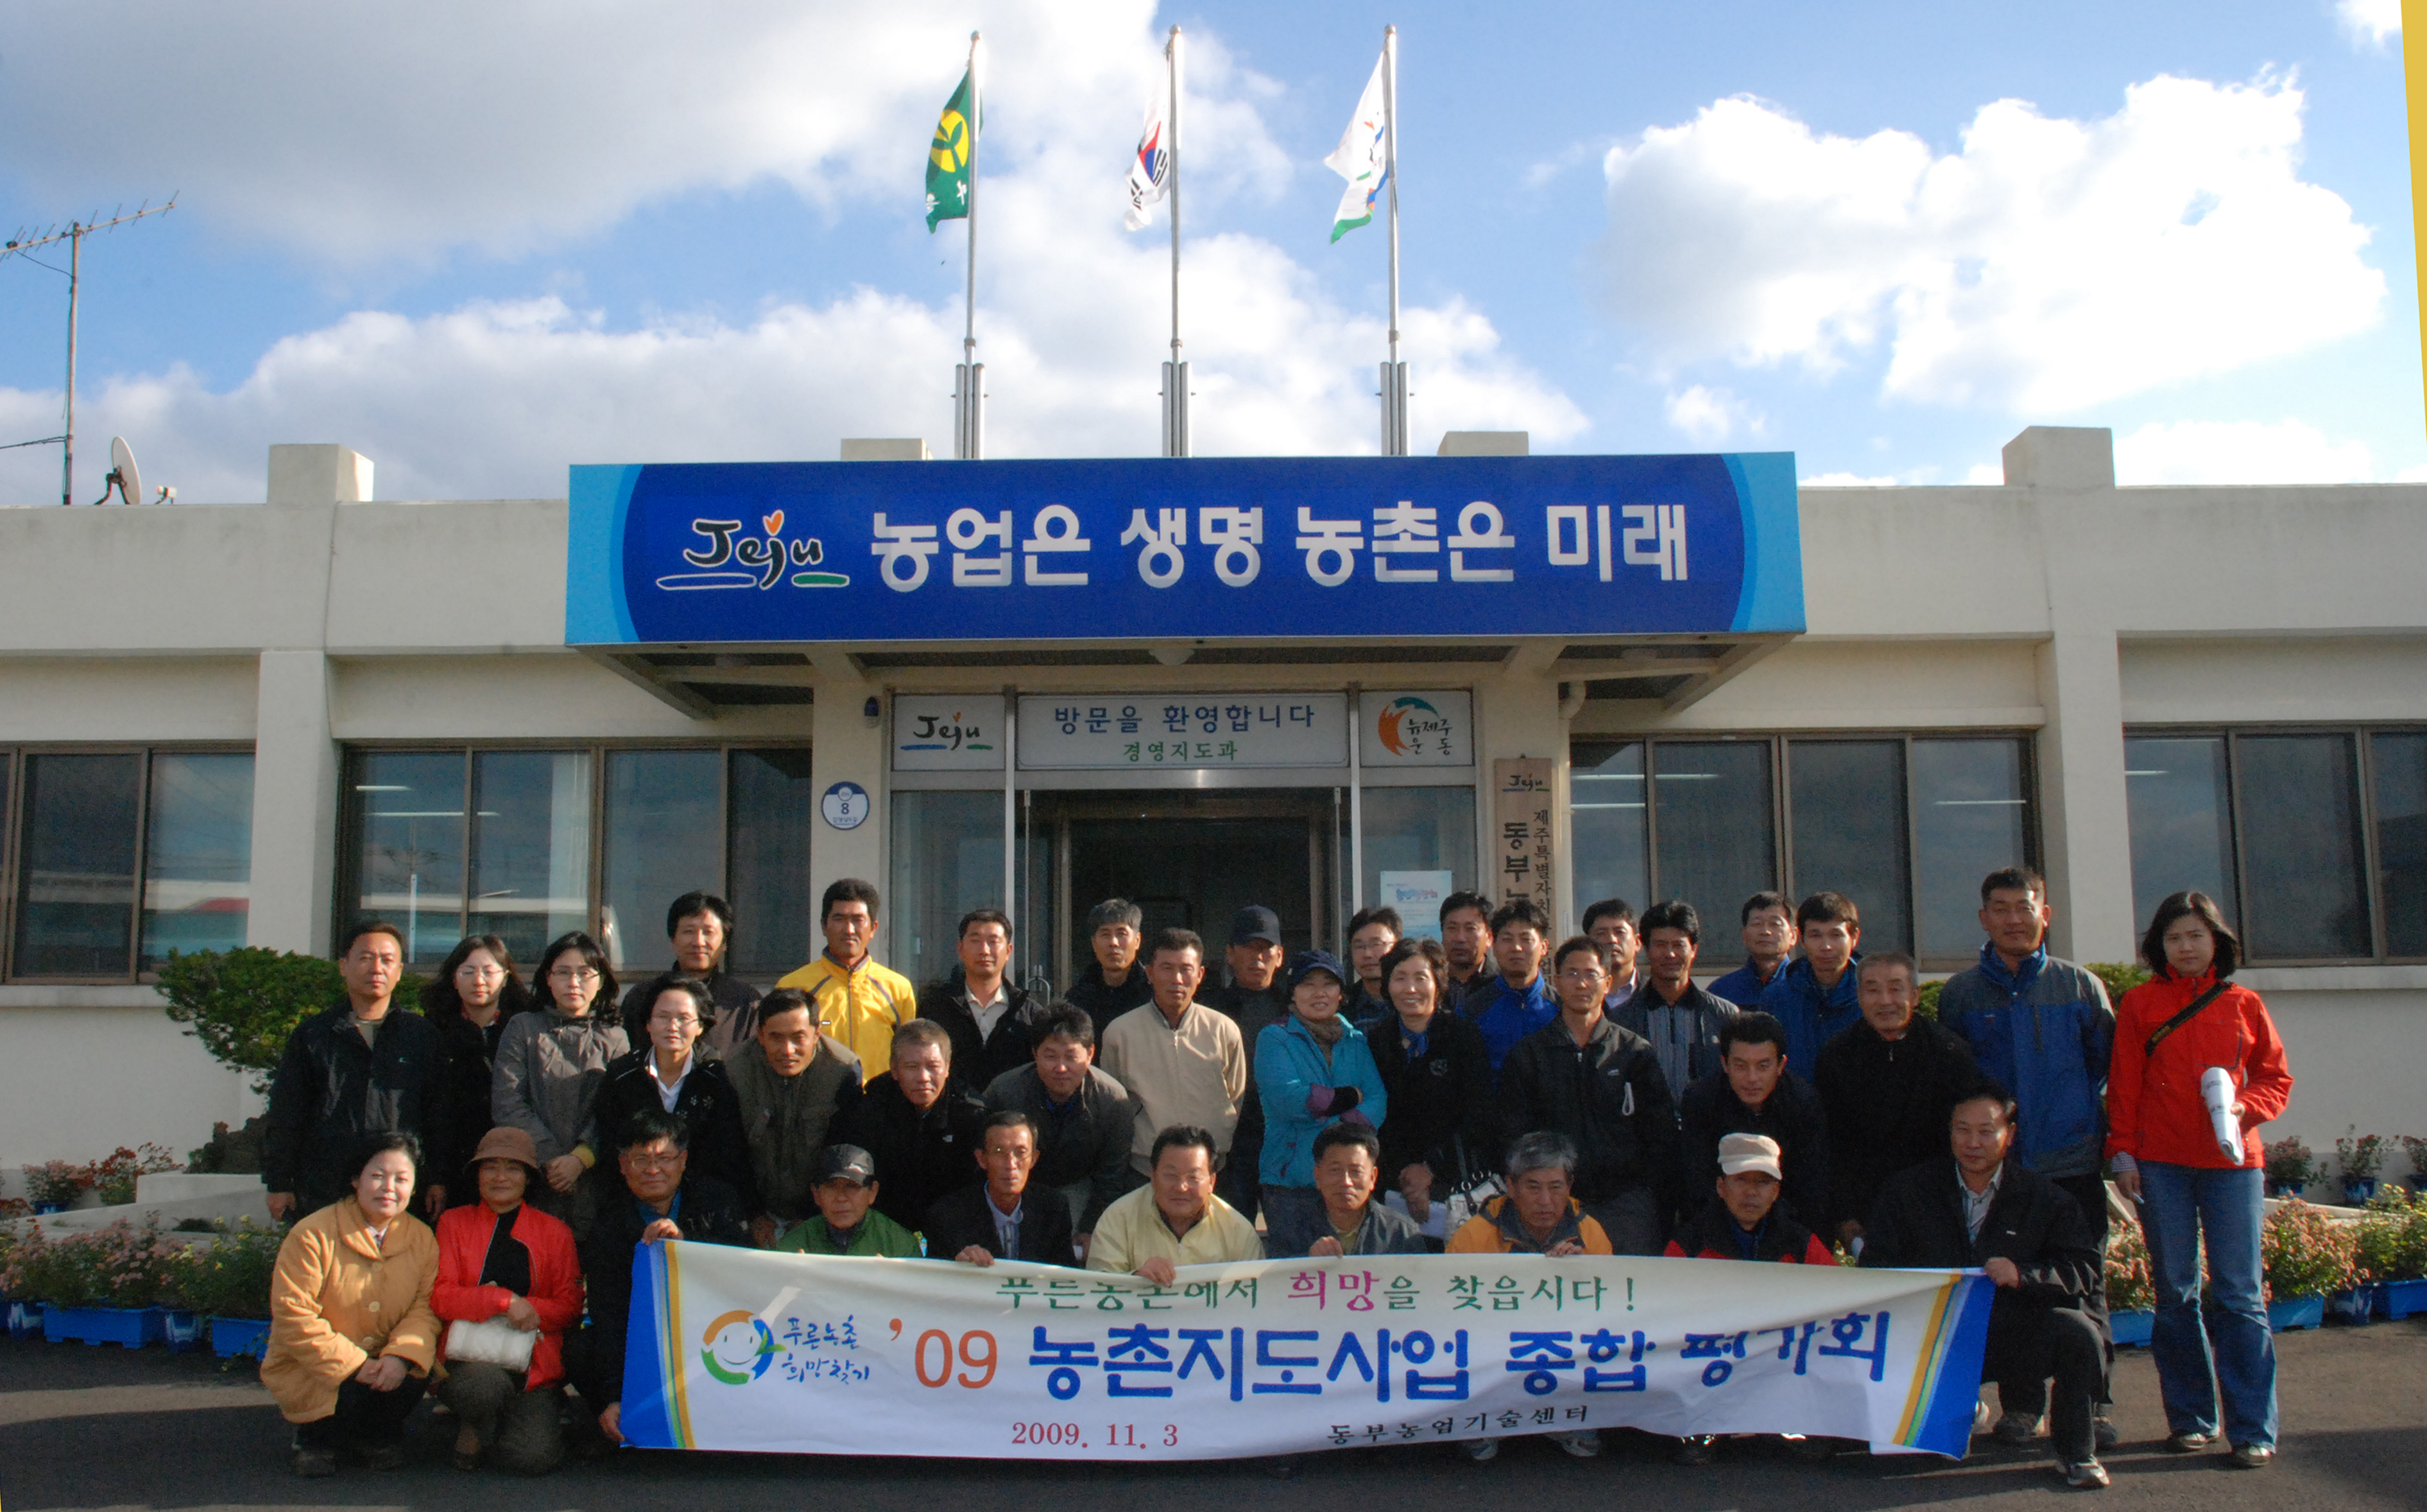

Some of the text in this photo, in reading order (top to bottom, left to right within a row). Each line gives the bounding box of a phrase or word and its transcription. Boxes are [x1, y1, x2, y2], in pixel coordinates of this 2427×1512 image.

[683, 510, 824, 590] Jeju
[871, 501, 1689, 593] 농업은 생명 농촌은 미래
[913, 712, 981, 751] Jeju
[1054, 704, 1315, 735] 방문을 환영합니다
[1406, 717, 1454, 736] 뉴제주
[1123, 740, 1238, 762] 경영지도과
[1509, 772, 1543, 792] Jeju
[841, 802, 850, 815] 8
[1287, 1269, 1420, 1311] 희망을
[782, 1314, 859, 1350] 푸른농촌
[1028, 1323, 1470, 1403] 농촌지도사업
[1505, 1327, 1656, 1396] 종합
[1679, 1310, 1891, 1387] 평가회
[1011, 1422, 1179, 1449] 2009. 11. 3
[1327, 1404, 1588, 1445] 동부농업기술센터
